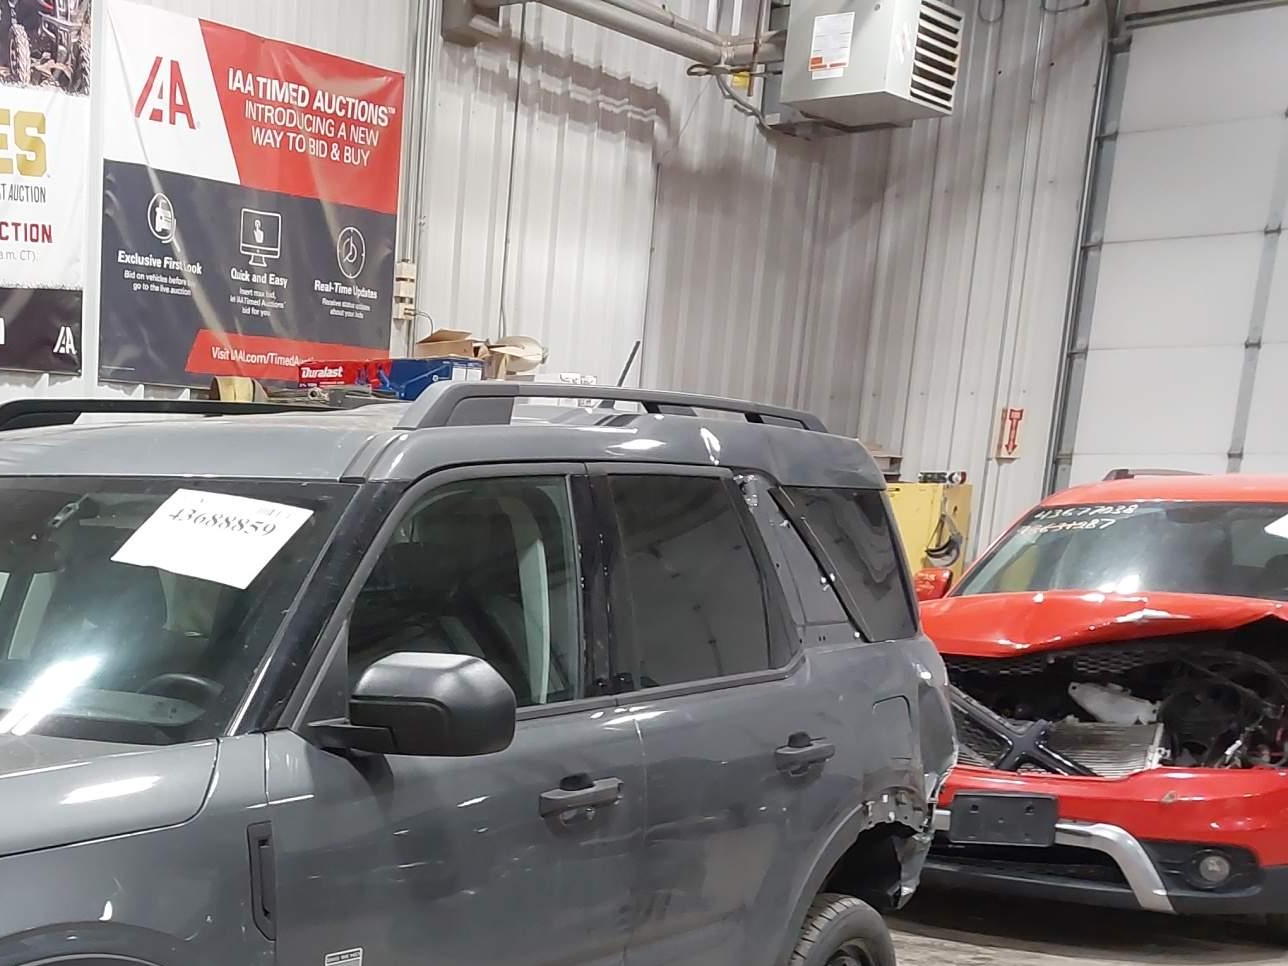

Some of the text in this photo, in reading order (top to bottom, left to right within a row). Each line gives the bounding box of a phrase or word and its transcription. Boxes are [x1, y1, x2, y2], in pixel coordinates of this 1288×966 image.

[228, 68, 255, 97] IAA
[256, 76, 309, 108] TIMED
[245, 99, 380, 147] INTRODUCING A NEW
[252, 126, 370, 167] WAY TO BID & BUY
[8, 184, 46, 203] AUCTION
[117, 250, 162, 268] Exclusive
[163, 256, 184, 271] First
[230, 268, 288, 289] Quick and Easy
[314, 279, 378, 299] Real-Time Updates
[212, 346, 230, 361] Visit
[300, 366, 344, 378] Duralast
[168, 508, 277, 537] 43688859
